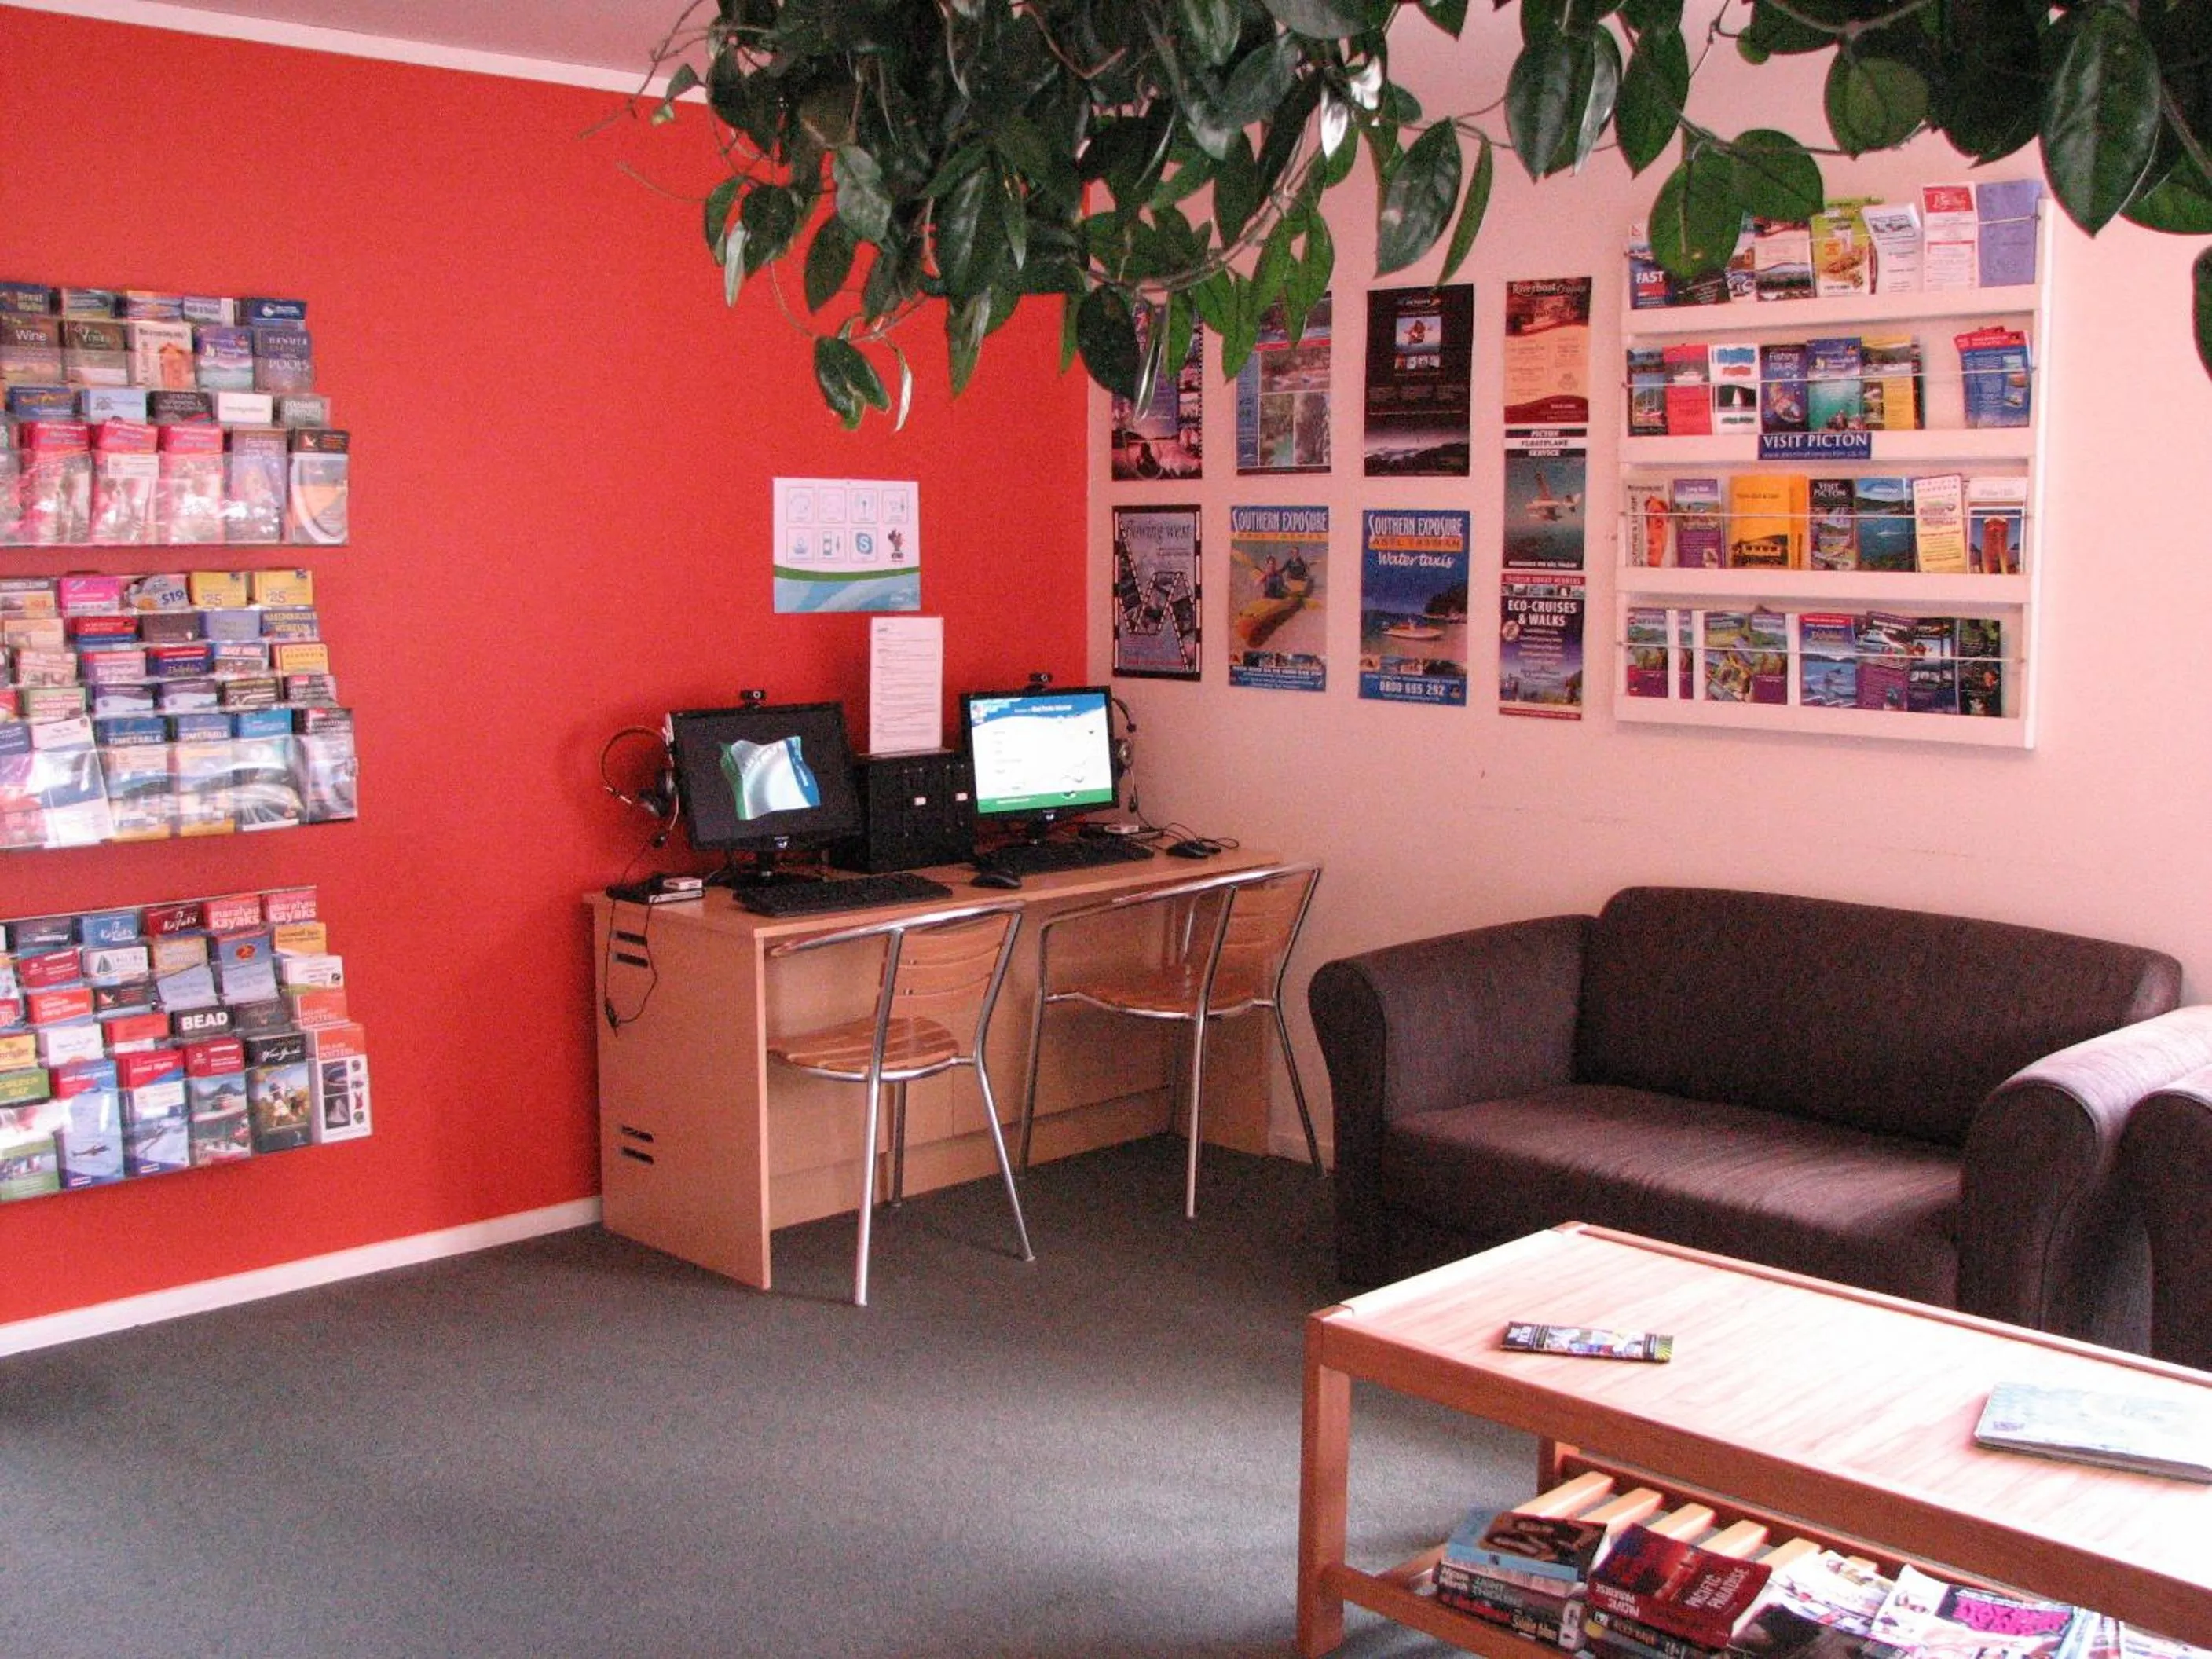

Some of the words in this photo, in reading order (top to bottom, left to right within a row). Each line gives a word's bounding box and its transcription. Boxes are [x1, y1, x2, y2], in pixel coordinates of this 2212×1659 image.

[16, 329, 47, 342] Wine
[269, 359, 309, 371] POOLS
[1763, 435, 1804, 448] VISIT
[1807, 433, 1868, 448] PICTON
[1232, 508, 1279, 533] SOUTHERN
[1282, 511, 1327, 533] EXPOSURE
[1368, 513, 1415, 537] SOUTHERN
[1418, 515, 1463, 537] EXPOSURE
[1378, 550, 1416, 566] Water
[1419, 552, 1454, 569] taxis
[1508, 599, 1577, 614] ECO-CRUISES
[1518, 613, 1525, 625] &
[1529, 613, 1566, 627] WALKS
[1379, 680, 1402, 693] 0800
[211, 915, 261, 930] kayaks
[181, 1012, 229, 1031] BEAD
[1685, 1573, 1722, 1608] PACIFIC
